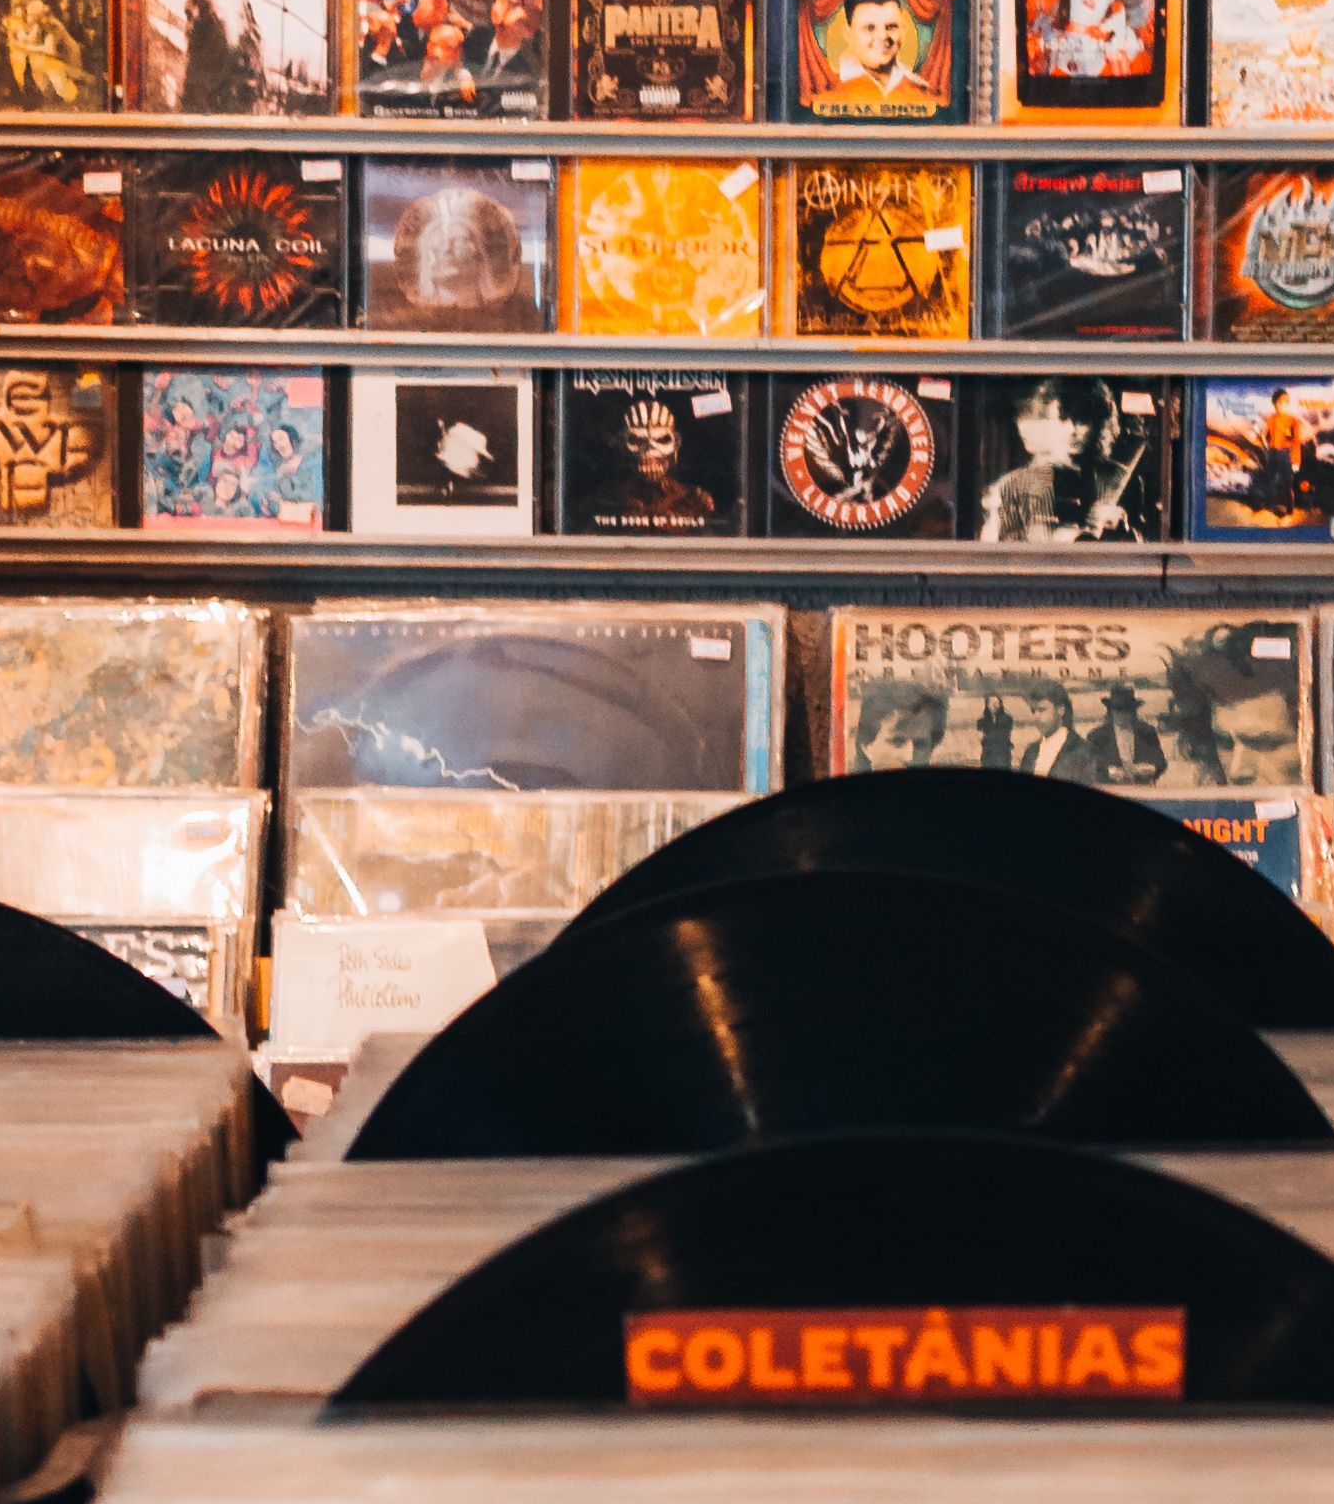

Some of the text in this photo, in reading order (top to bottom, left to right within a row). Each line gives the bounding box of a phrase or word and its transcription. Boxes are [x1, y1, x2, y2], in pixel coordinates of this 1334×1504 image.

[605, 5, 726, 51] PANTERA
[168, 237, 328, 254] LACUNA COIL
[582, 237, 752, 258] SUPERIOR
[855, 622, 1129, 661] HOOTERS
[625, 1306, 1183, 1392] COLETÂNIAS
